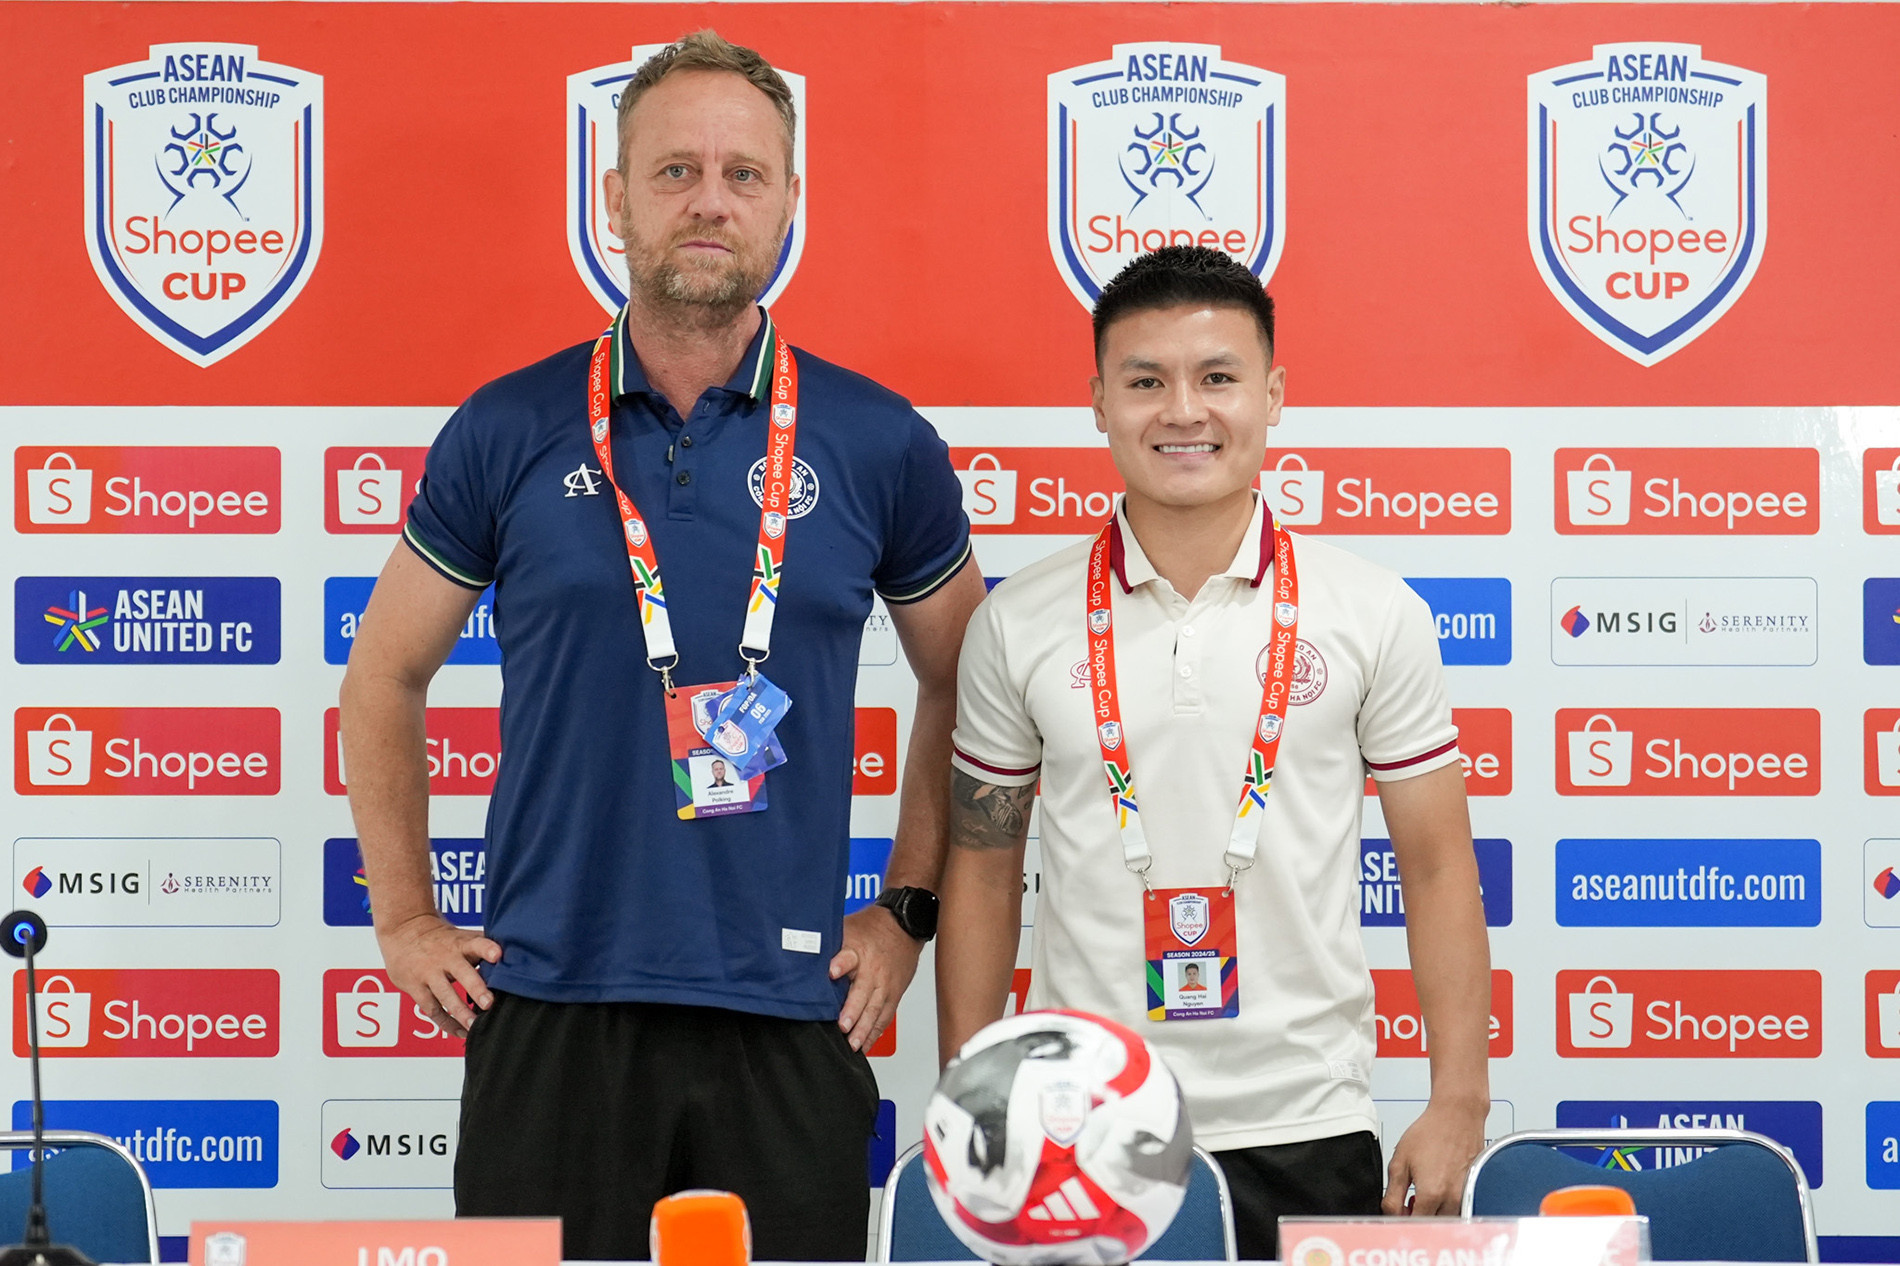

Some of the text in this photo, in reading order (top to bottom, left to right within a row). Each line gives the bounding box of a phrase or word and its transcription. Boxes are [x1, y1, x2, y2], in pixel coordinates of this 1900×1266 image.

[163, 54, 245, 83] ASEAN
[1127, 54, 1207, 82] ASEAN
[1607, 54, 1688, 82] ASEAN
[129, 87, 280, 109] CLUB CHAMPIONSHIP
[1092, 86, 1243, 108] CLUB CHAMPIONSHIP
[1572, 86, 1723, 108] CLUB CHAMPIONSHIP
[125, 216, 283, 265] Shopee
[1568, 215, 1727, 265] Shopee
[163, 272, 246, 301] CUP
[1605, 271, 1689, 299] CUP
[591, 352, 606, 393] Shopee
[775, 376, 792, 400] Cup
[592, 393, 606, 417] Cup
[771, 433, 789, 479] Shopee
[104, 477, 268, 528] Shopee
[767, 481, 785, 508] Cup
[1336, 478, 1499, 529] Shopee
[1643, 478, 1807, 529] Shopee
[1090, 540, 1106, 580] Shopee
[1278, 537, 1291, 576] Shopee
[1089, 581, 1105, 606] Cup
[1276, 576, 1293, 600] Cup
[114, 590, 203, 619] ASEAN
[1597, 612, 1677, 633] MSIG
[1721, 615, 1809, 627] SERENITY
[114, 622, 252, 652] UNITED FC
[1092, 639, 1108, 687] Shopee
[1274, 631, 1291, 679] Shopee
[1096, 689, 1112, 718] Cup
[1265, 680, 1285, 710] Cup
[750, 702, 767, 720] 06
[104, 738, 268, 790] Shopee
[426, 738, 502, 778] Sho
[1645, 738, 1808, 790] Shopee
[59, 873, 139, 894] MSIG
[184, 876, 272, 888] SERENITY
[1571, 866, 1806, 901] aseanutdfc.com
[1178, 993, 1197, 1001] Quang
[103, 1000, 267, 1051] Shopee
[1646, 1000, 1809, 1052] Shopee
[367, 1134, 447, 1156] MSIG
